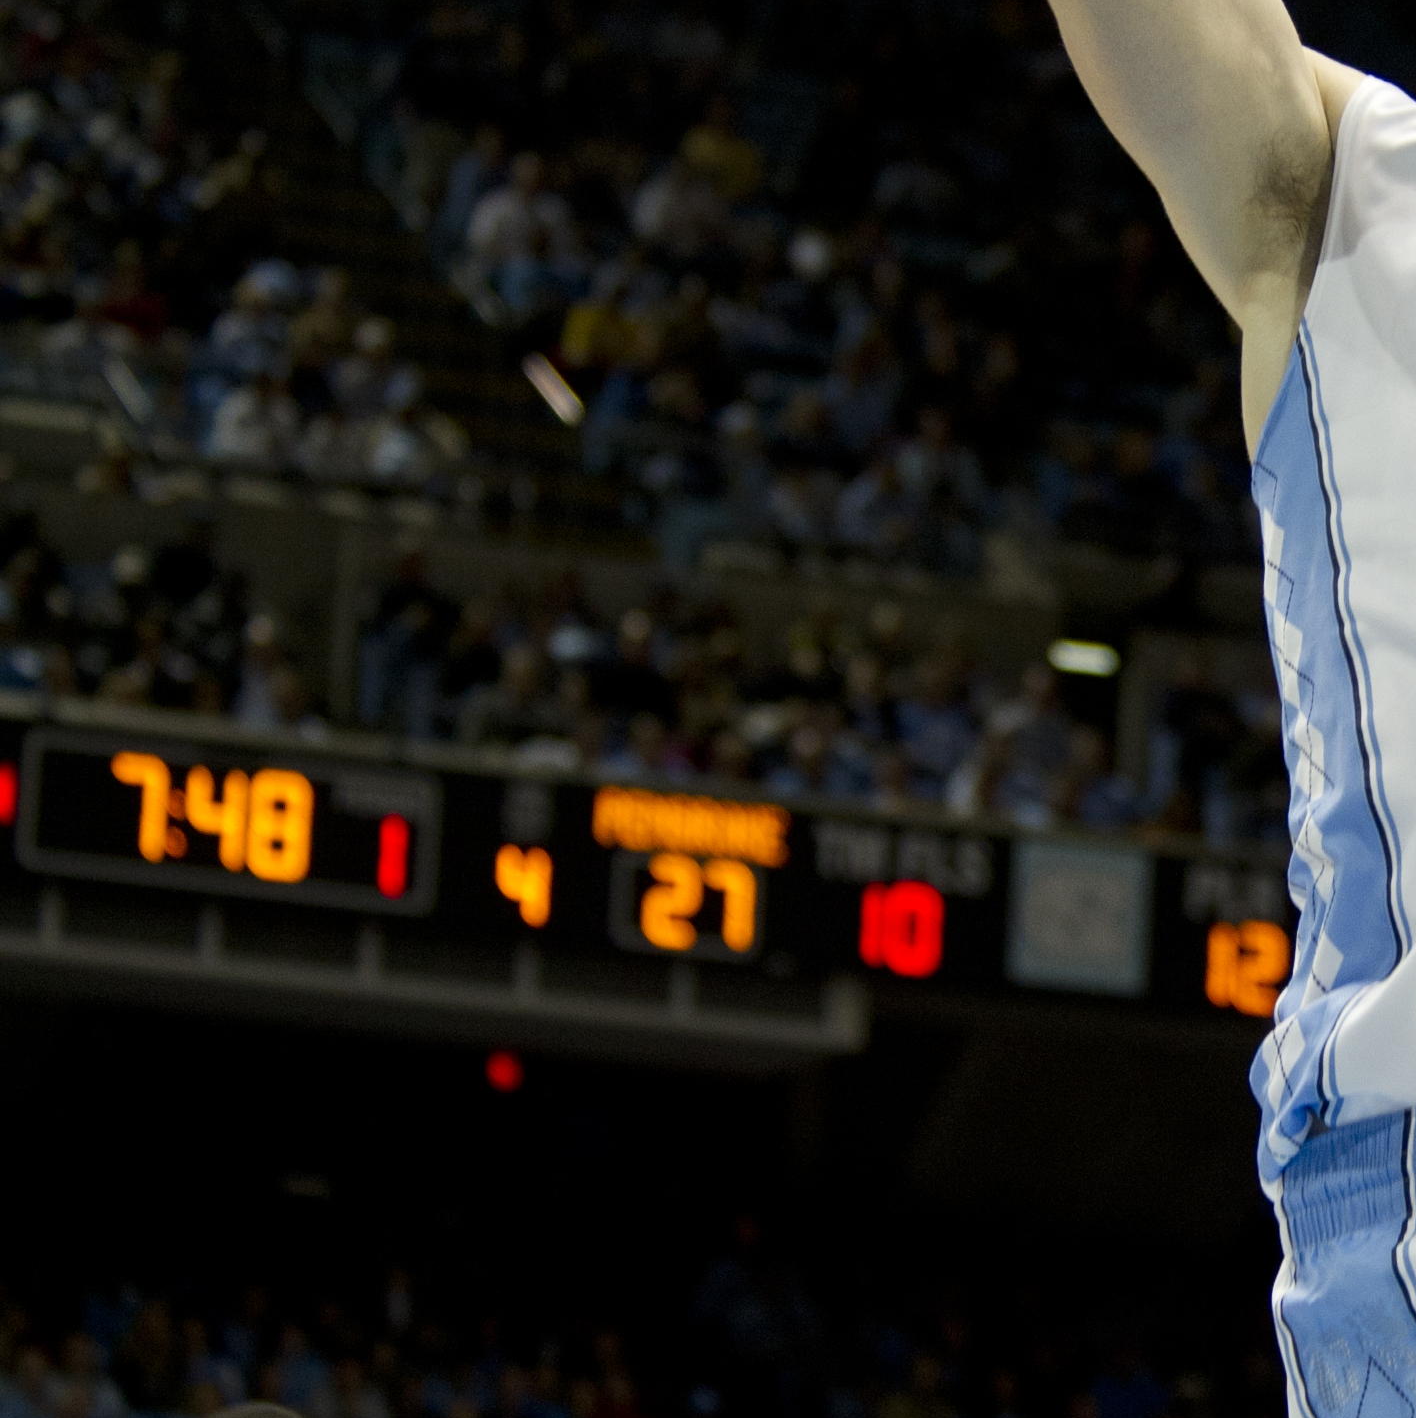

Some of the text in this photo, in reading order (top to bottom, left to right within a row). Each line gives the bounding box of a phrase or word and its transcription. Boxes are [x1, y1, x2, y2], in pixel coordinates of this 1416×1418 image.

[110, 750, 315, 883] 7:48
[640, 852, 757, 952] 27
[858, 879, 945, 978] 10
